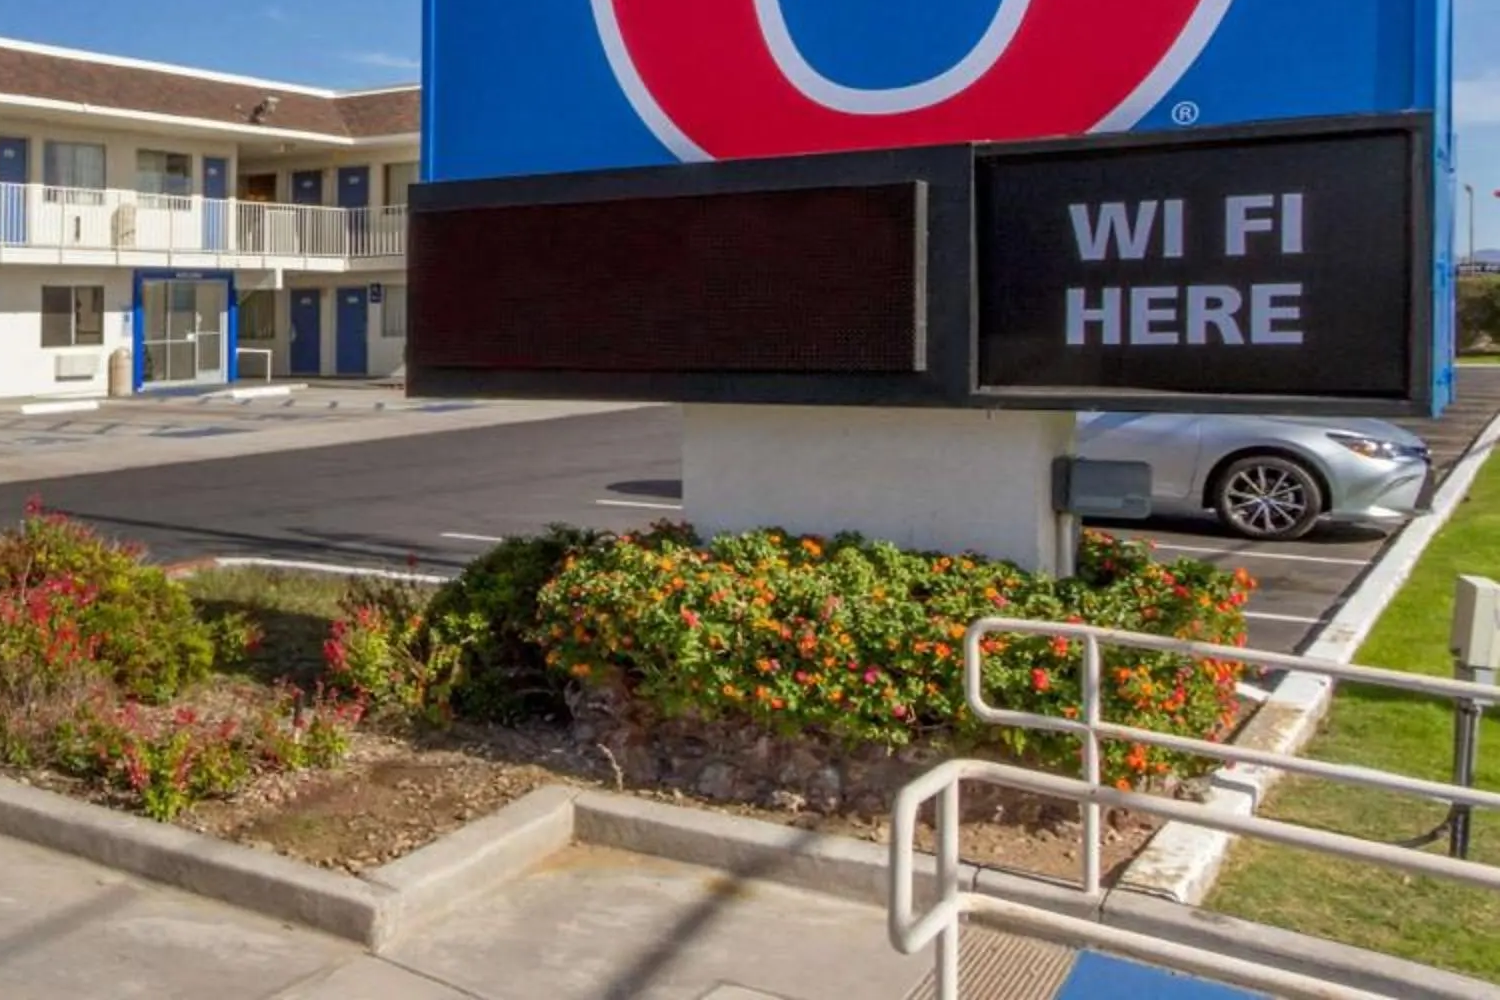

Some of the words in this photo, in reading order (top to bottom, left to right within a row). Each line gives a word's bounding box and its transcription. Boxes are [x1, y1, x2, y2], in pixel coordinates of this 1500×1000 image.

[1068, 199, 1184, 261] WI
[1225, 193, 1304, 256] FI
[1065, 282, 1304, 345] HERE
